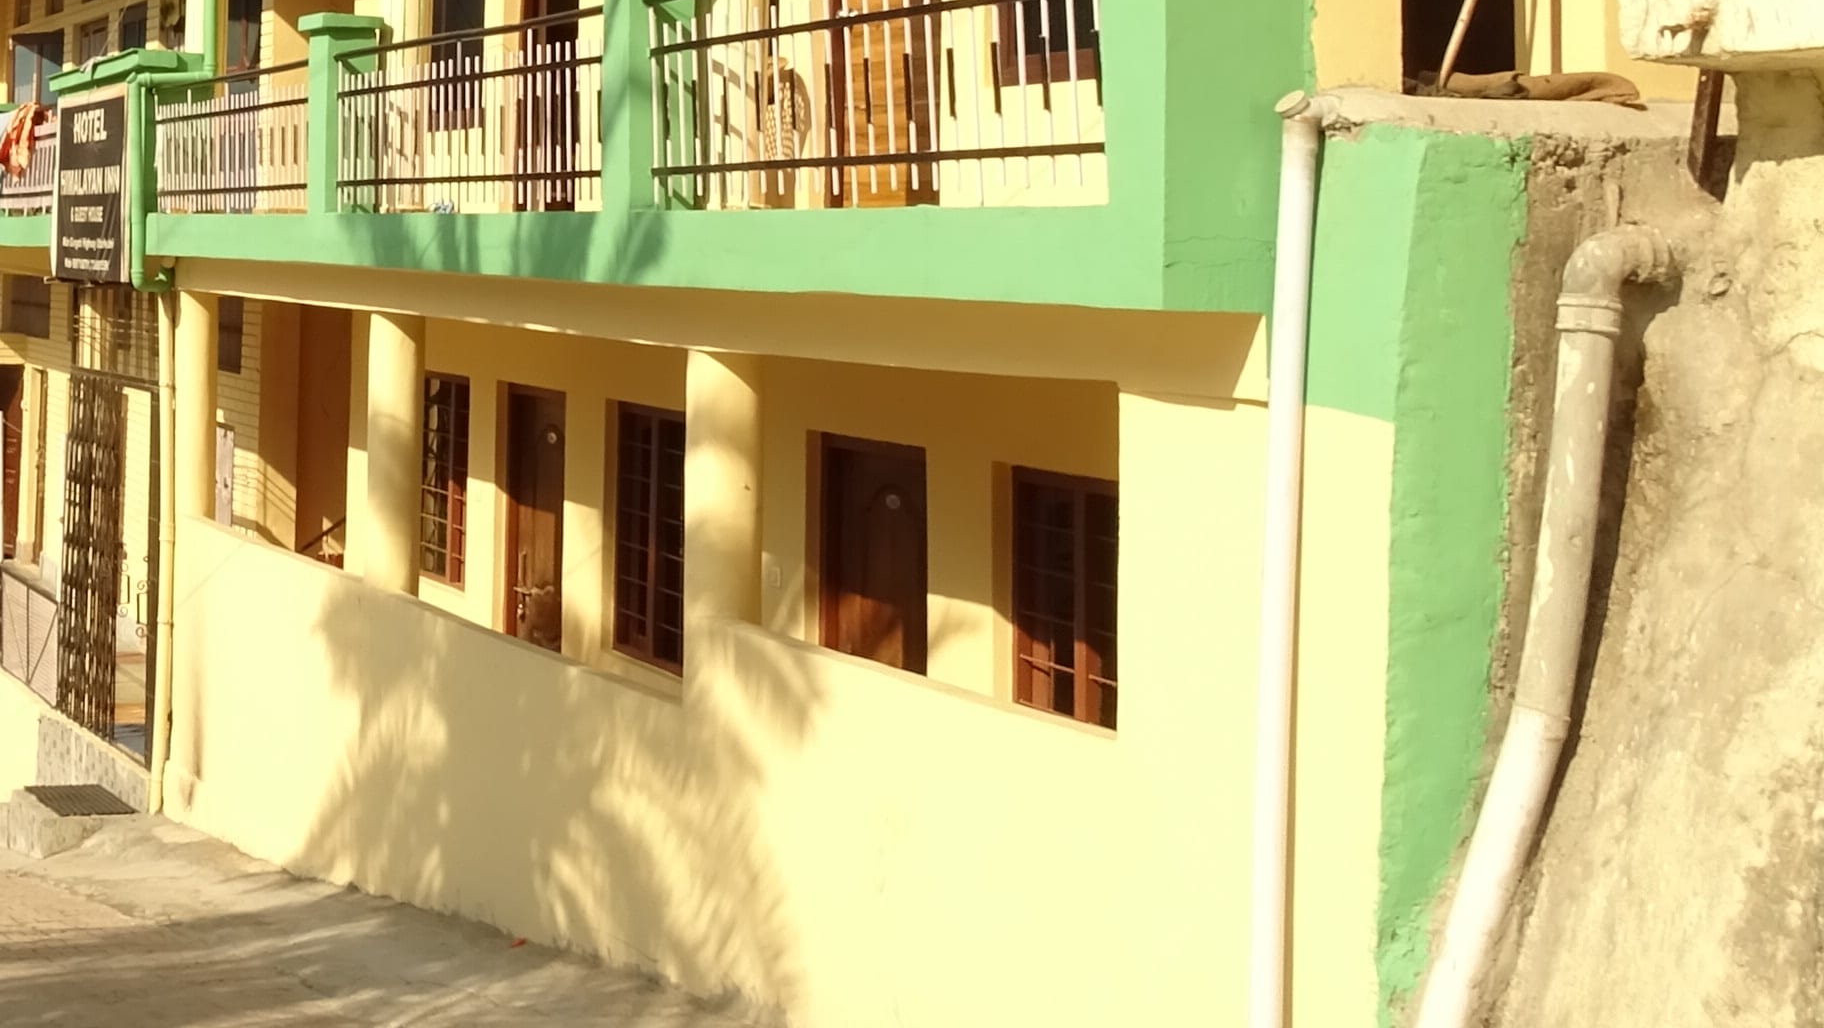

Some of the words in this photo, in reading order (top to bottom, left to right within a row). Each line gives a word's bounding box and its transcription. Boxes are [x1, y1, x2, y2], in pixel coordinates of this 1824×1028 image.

[73, 108, 107, 144] HOTEL
[60, 167, 103, 195] HIMALAYAN
[104, 164, 120, 194] INN
